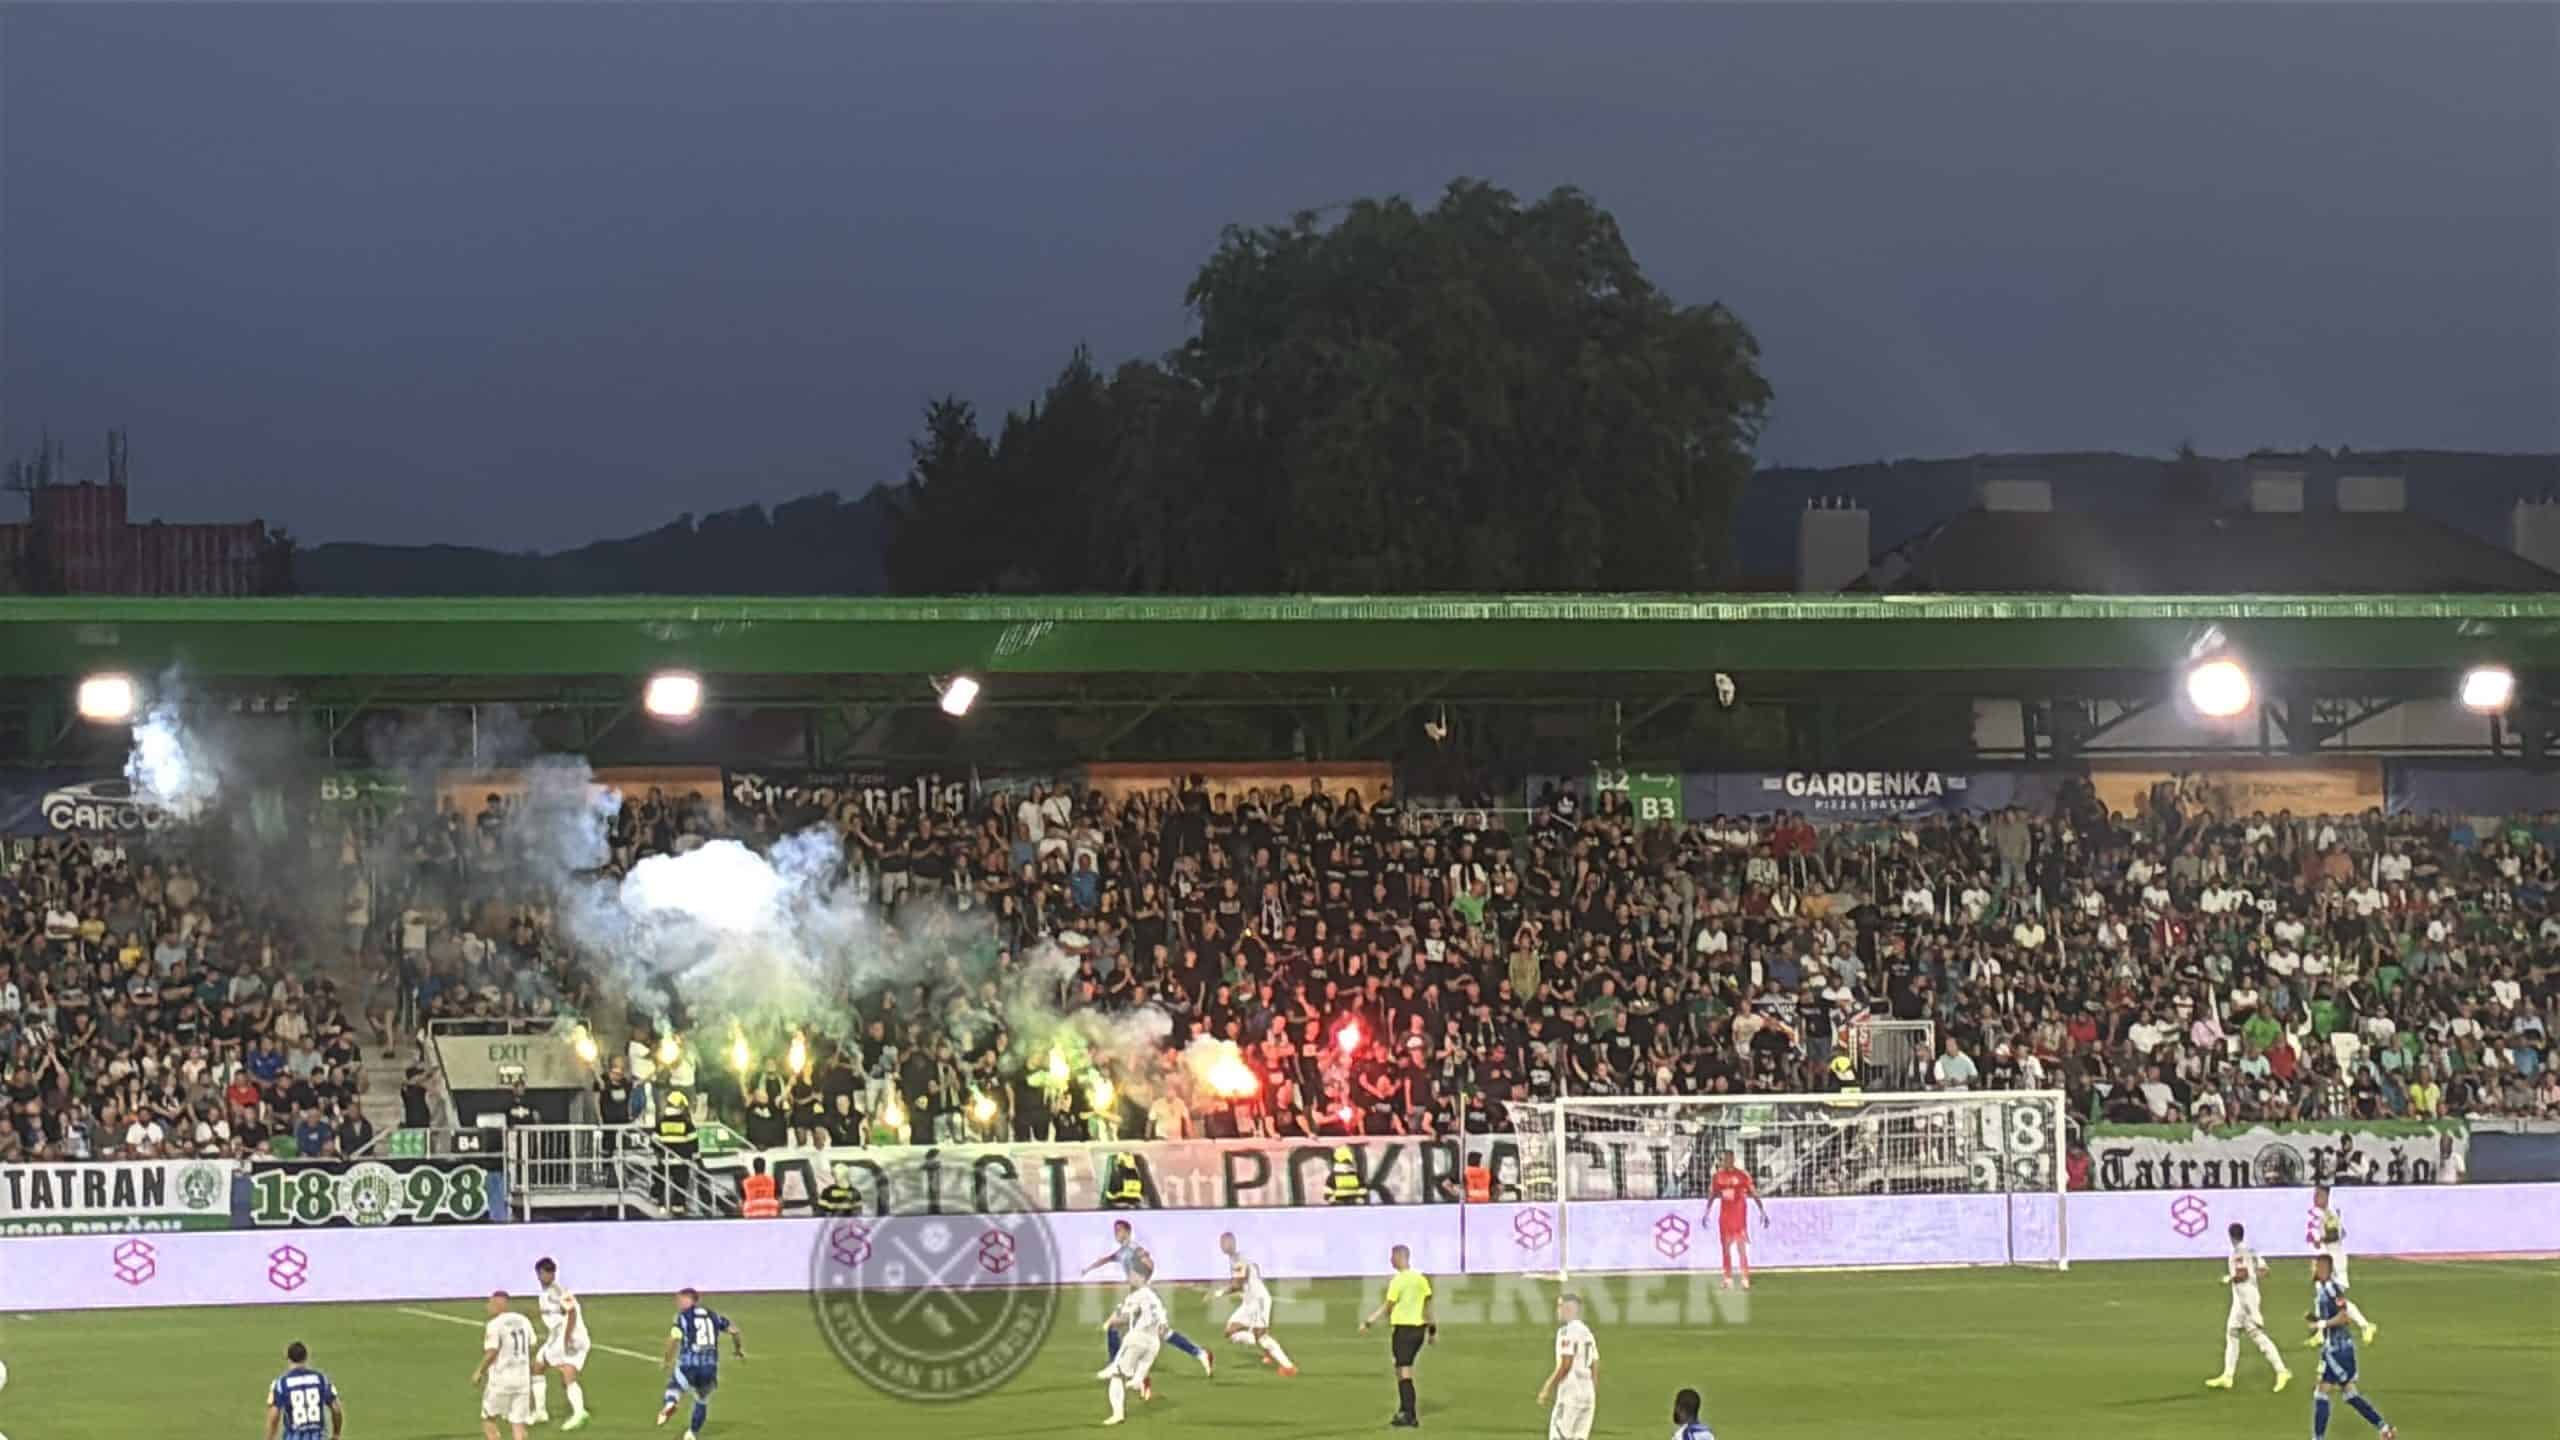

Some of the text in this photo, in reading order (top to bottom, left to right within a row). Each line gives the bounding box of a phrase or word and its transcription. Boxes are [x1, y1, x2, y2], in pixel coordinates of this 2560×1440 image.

[1785, 771, 1943, 797] GARDENKA
[1642, 797, 1675, 820] B3
[488, 1044, 528, 1061] EXIT
[457, 1136, 480, 1151] B4
[2100, 1146, 2250, 1189] Tatran
[4, 1167, 165, 1210] TATRAN
[511, 1328, 527, 1356] 11
[694, 1317, 715, 1345] 21
[290, 1388, 322, 1425] 88
